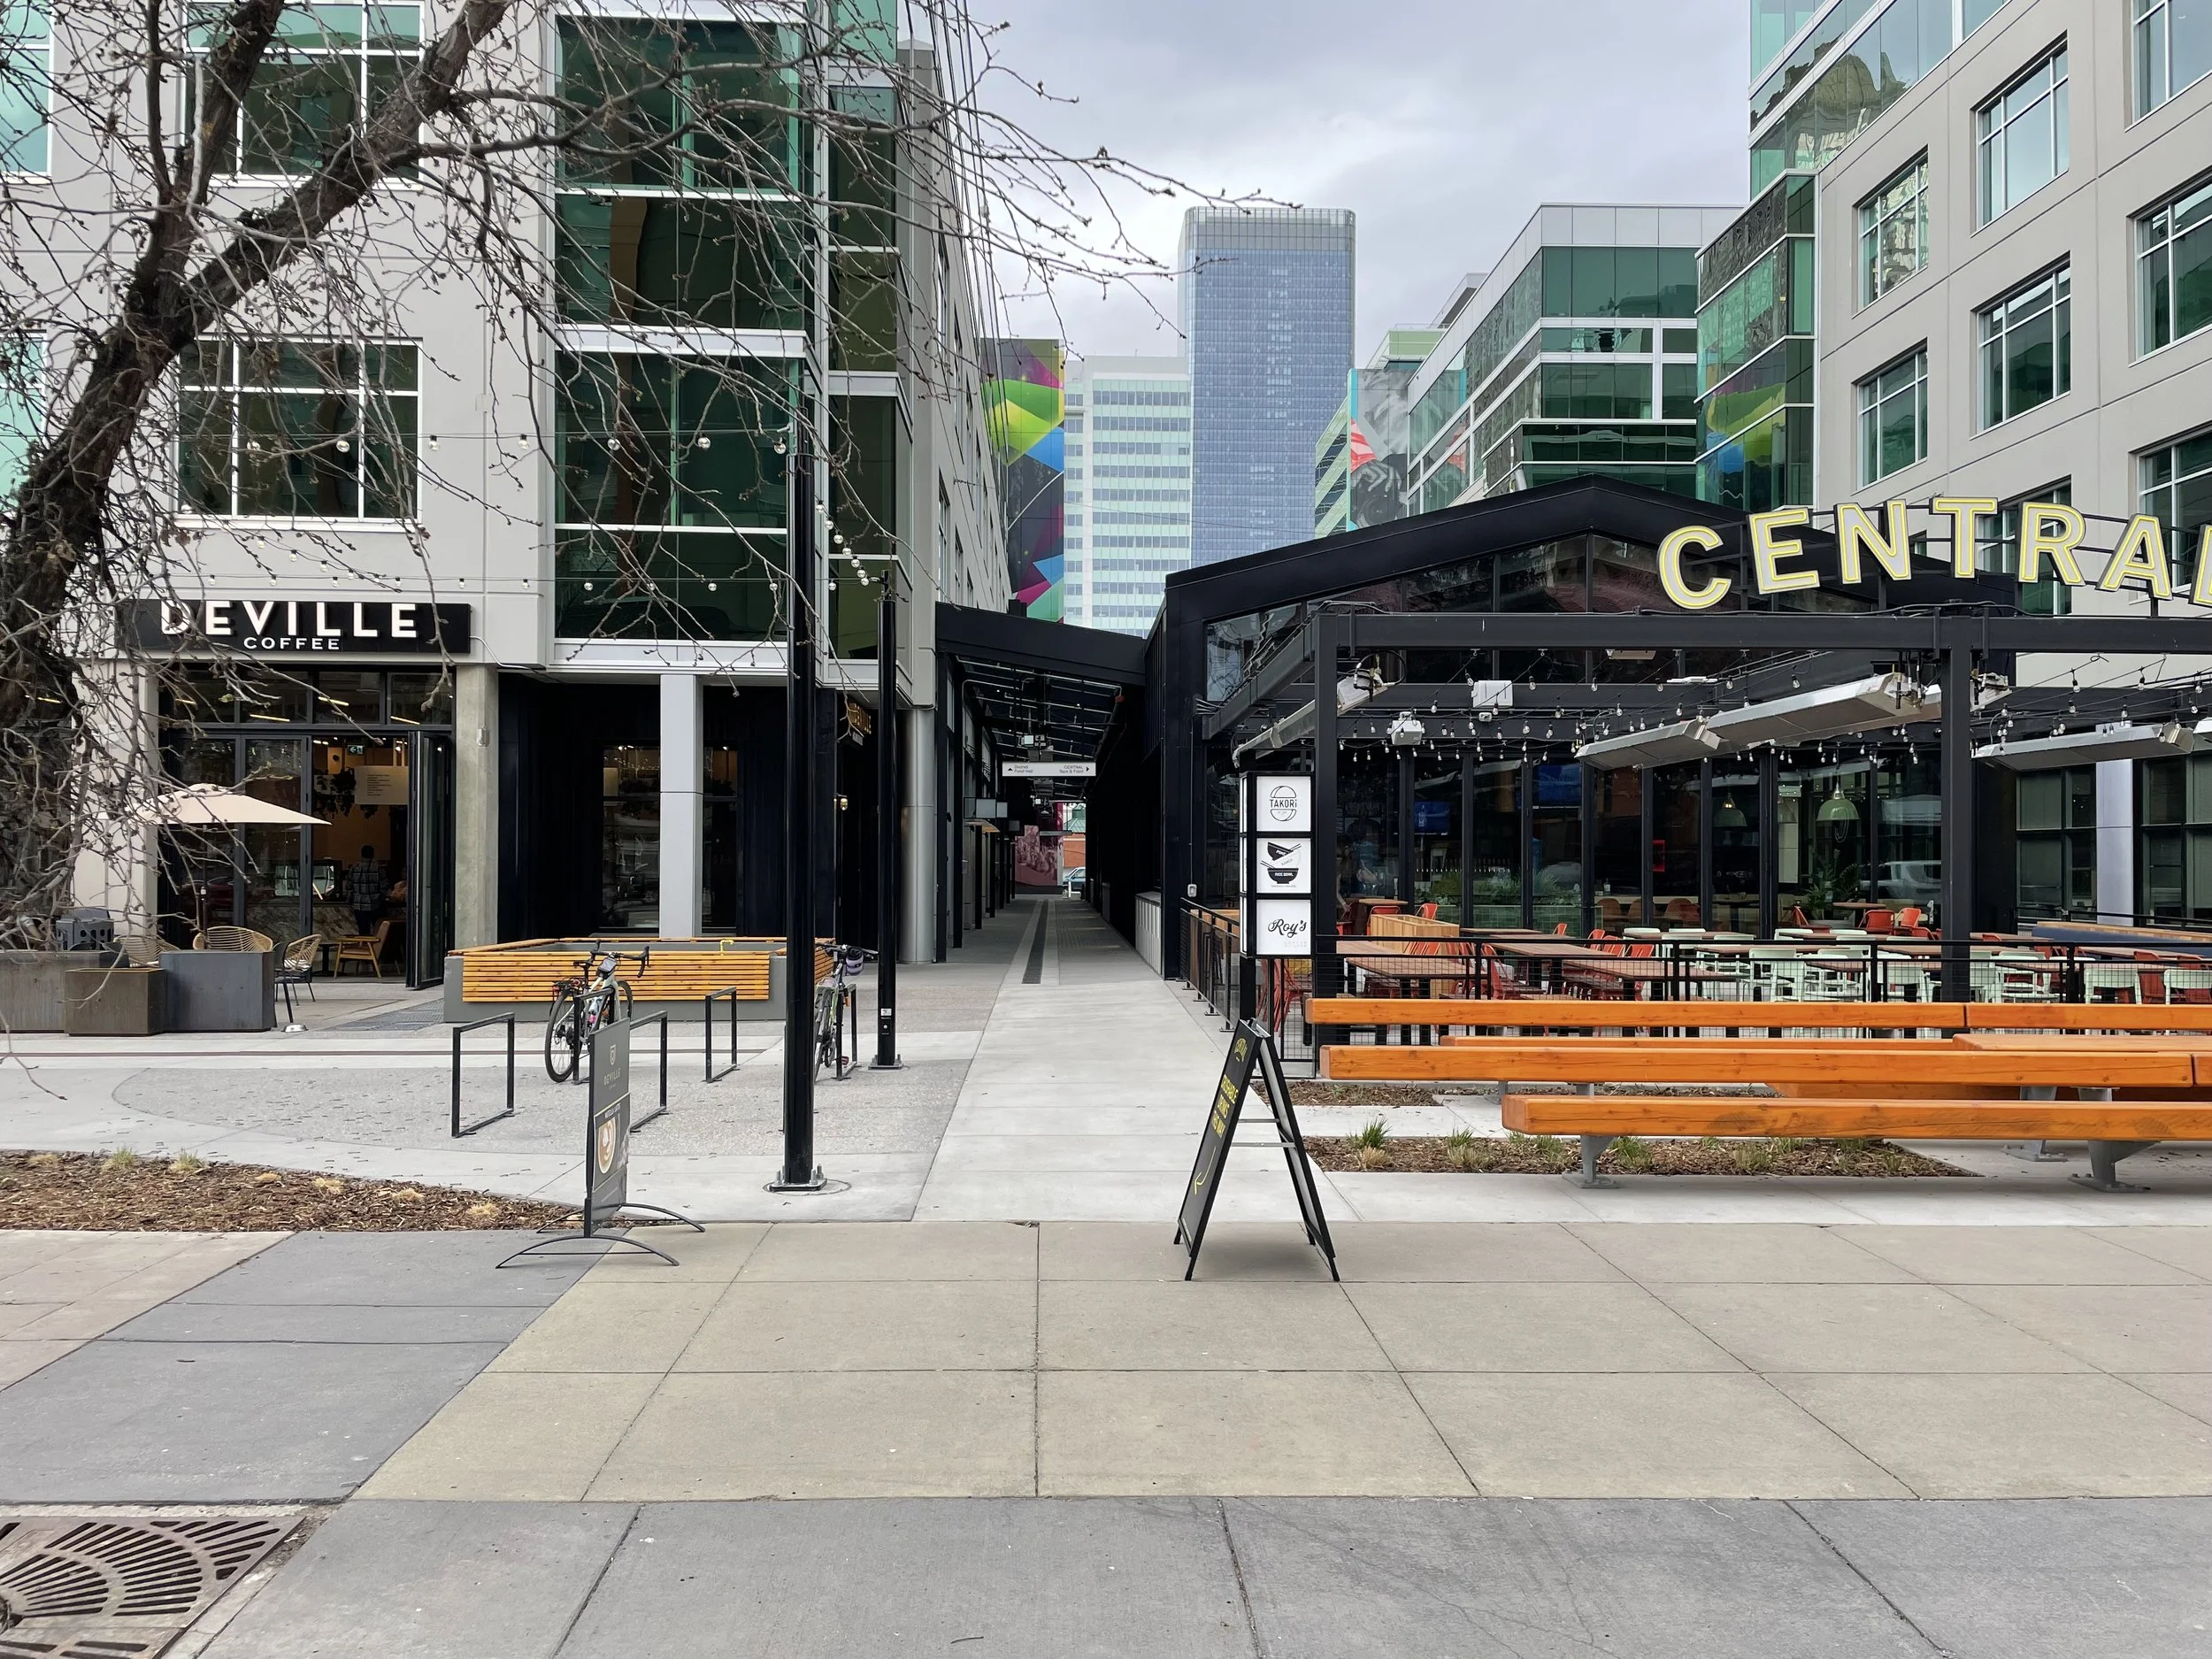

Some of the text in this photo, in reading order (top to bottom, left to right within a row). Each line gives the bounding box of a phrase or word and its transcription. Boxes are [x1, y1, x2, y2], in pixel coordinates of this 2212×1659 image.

[160, 599, 417, 638] DEVILLE
[243, 637, 340, 649] COFFEE
[1268, 918, 1307, 939] Roy's
